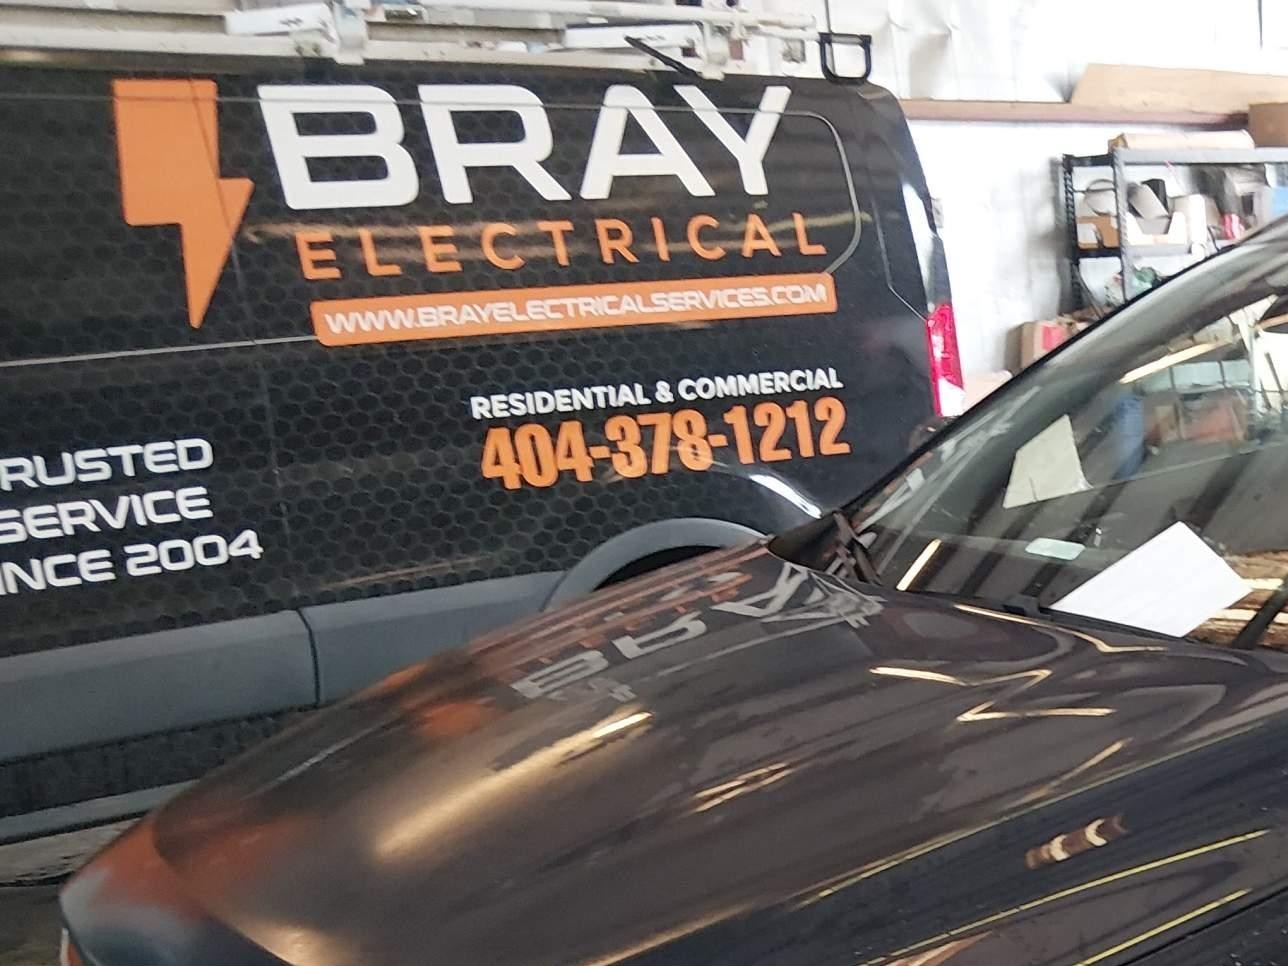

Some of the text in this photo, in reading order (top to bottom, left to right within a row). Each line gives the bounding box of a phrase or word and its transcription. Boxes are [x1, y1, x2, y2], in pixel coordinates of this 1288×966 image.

[258, 84, 791, 210] BRAY
[296, 213, 827, 280] ELECTRICAL
[326, 283, 828, 335] WWW.BRAYELECTRICALSERVICES.COM
[470, 367, 844, 420] RESIDENTIAL & COMMERCIAL
[481, 396, 850, 490] 404-378-1212
[0, 486, 213, 544] SERVICE
[123, 529, 264, 577] 2004
